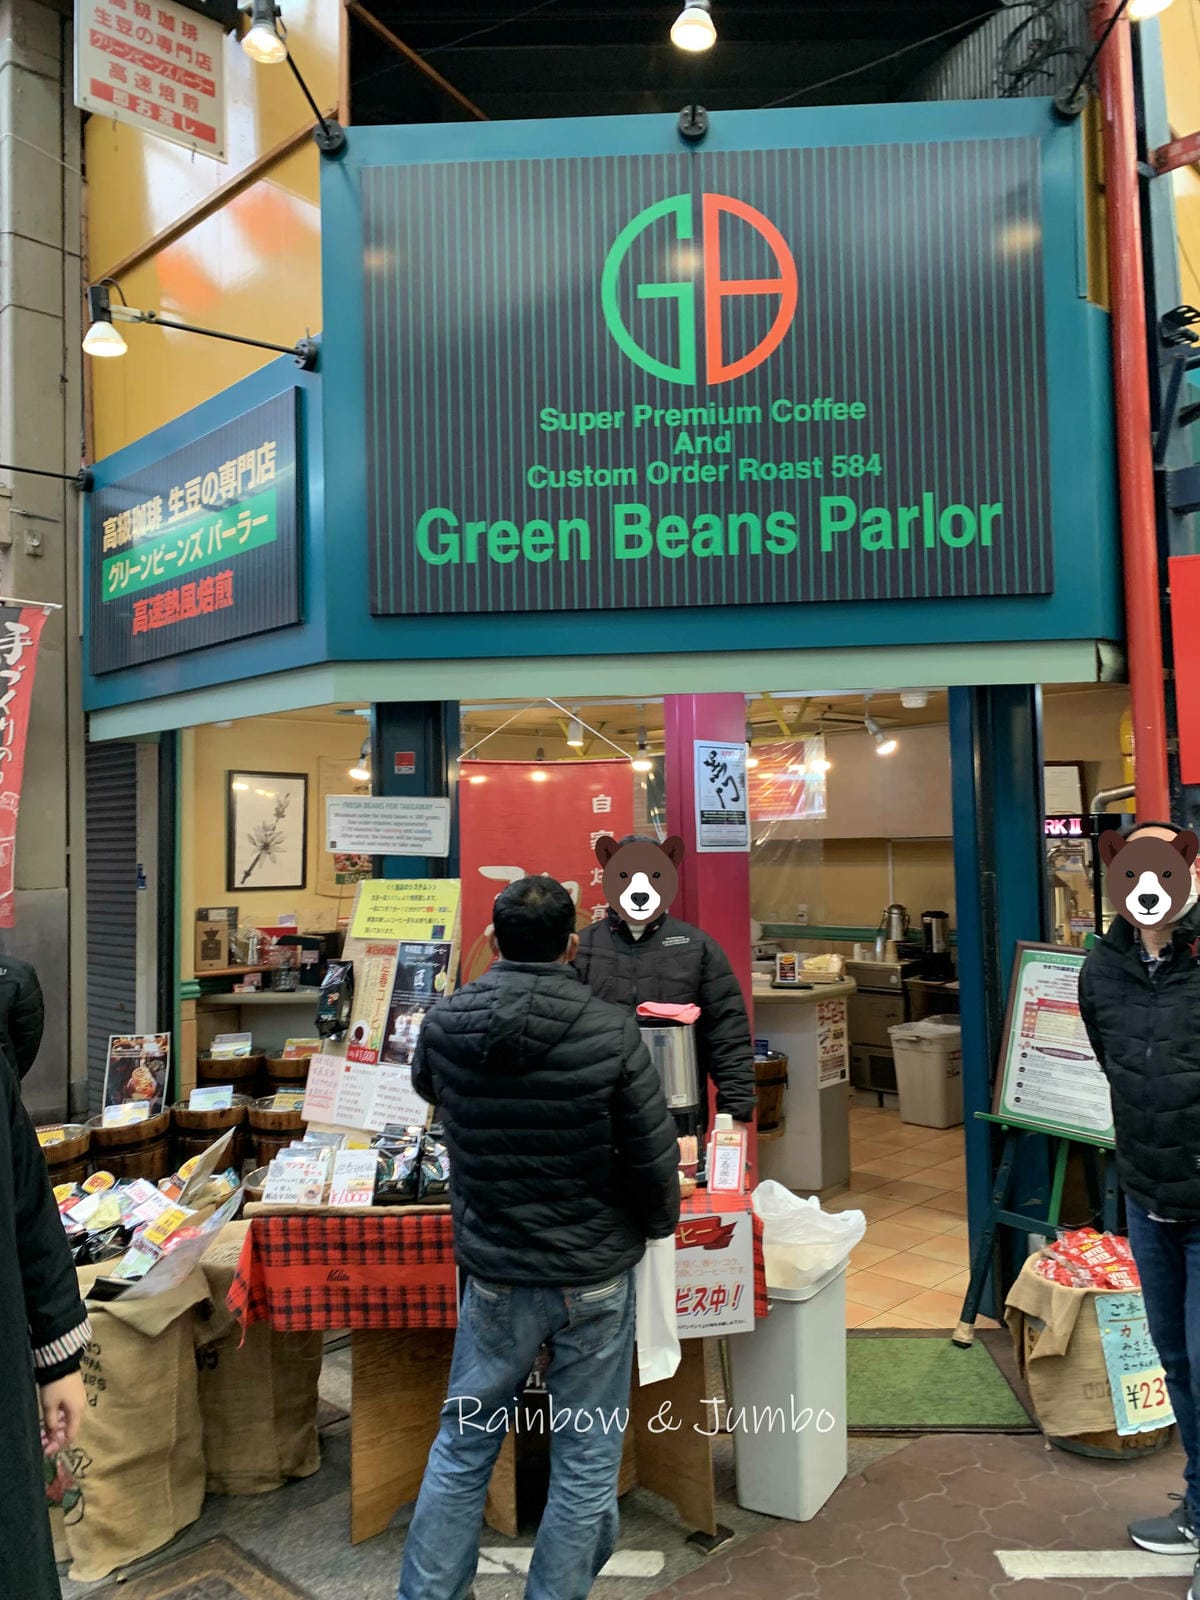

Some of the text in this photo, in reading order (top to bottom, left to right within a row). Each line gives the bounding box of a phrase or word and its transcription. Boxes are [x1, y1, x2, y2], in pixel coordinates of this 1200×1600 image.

[93, 6, 212, 72] 生豆の専門店
[539, 398, 867, 436] Super Premium Coffee
[673, 430, 732, 455] And
[167, 440, 277, 524] 生豆の専門店
[527, 453, 883, 489] Custom Order Roast 584
[416, 491, 1003, 566] Green Beans Parlor
